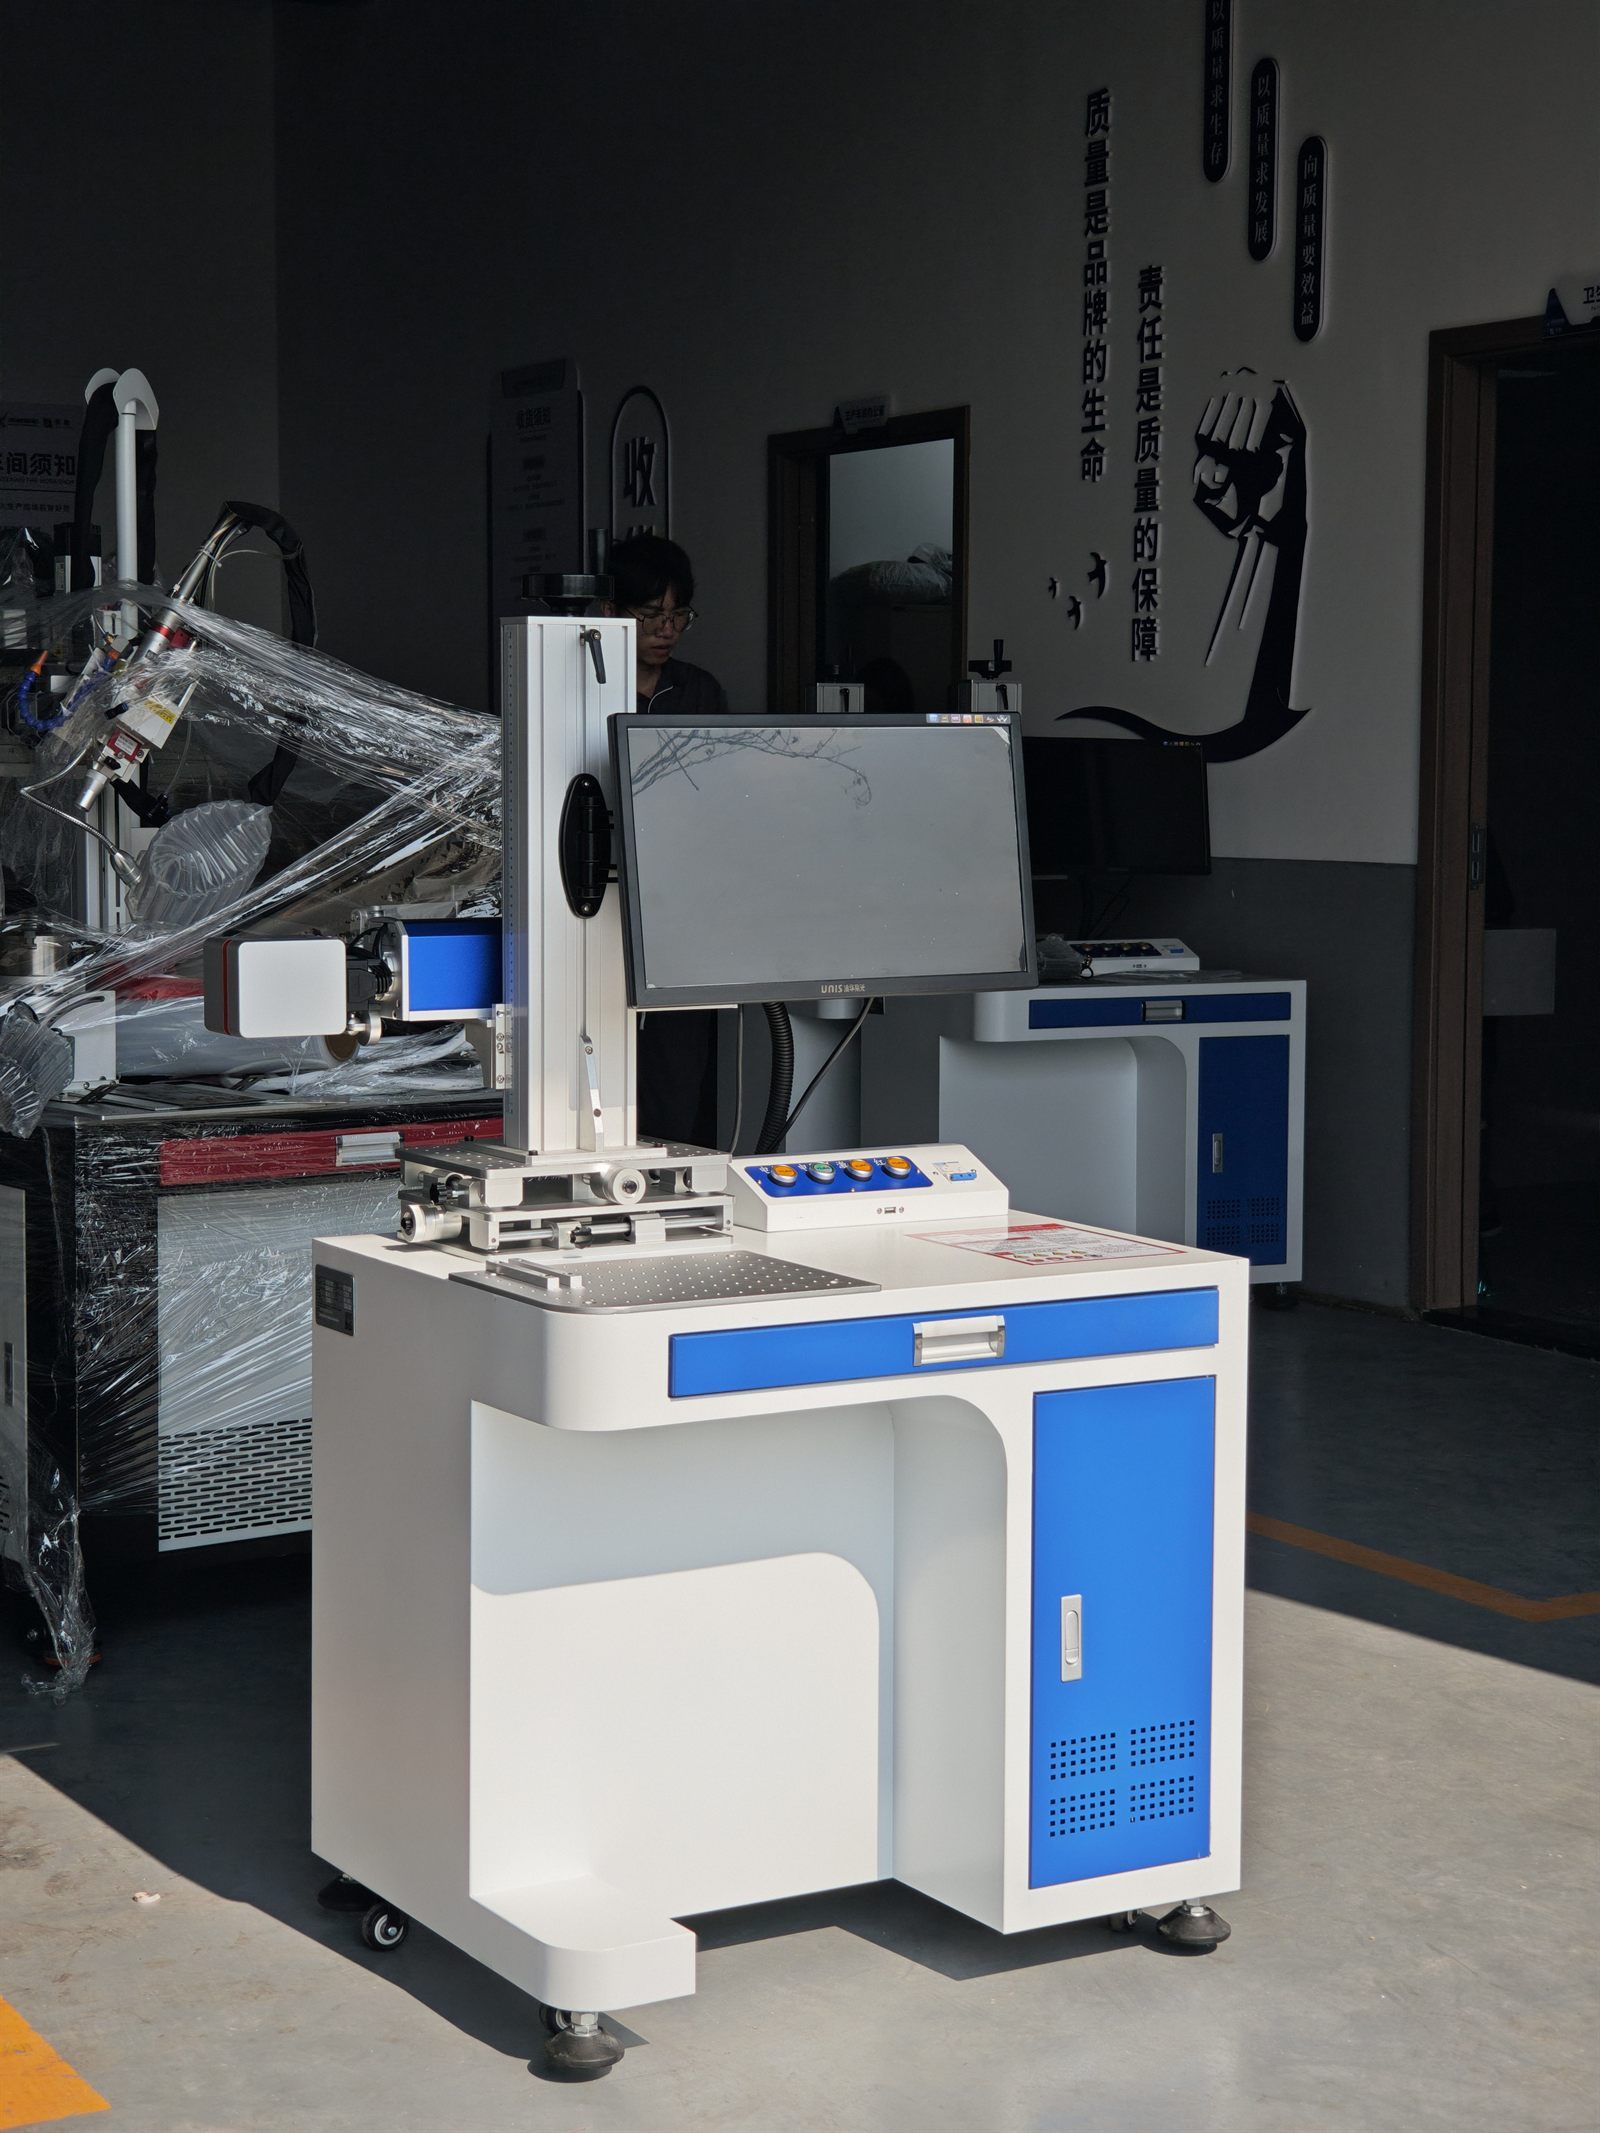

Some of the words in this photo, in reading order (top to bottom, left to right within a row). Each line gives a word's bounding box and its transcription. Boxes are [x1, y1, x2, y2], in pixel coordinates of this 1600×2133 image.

[1210, 0, 1226, 166] 以质量求生存
[1254, 74, 1271, 243] 以质量求发展
[1081, 88, 1110, 482] 质量是品牌的生命
[1300, 154, 1319, 325] 向质量要效益
[1583, 286, 1600, 304] 卫
[0, 452, 75, 476] 间须知
[1132, 265, 1163, 662] 责任是质量的保障
[821, 984, 843, 994] UNIS
